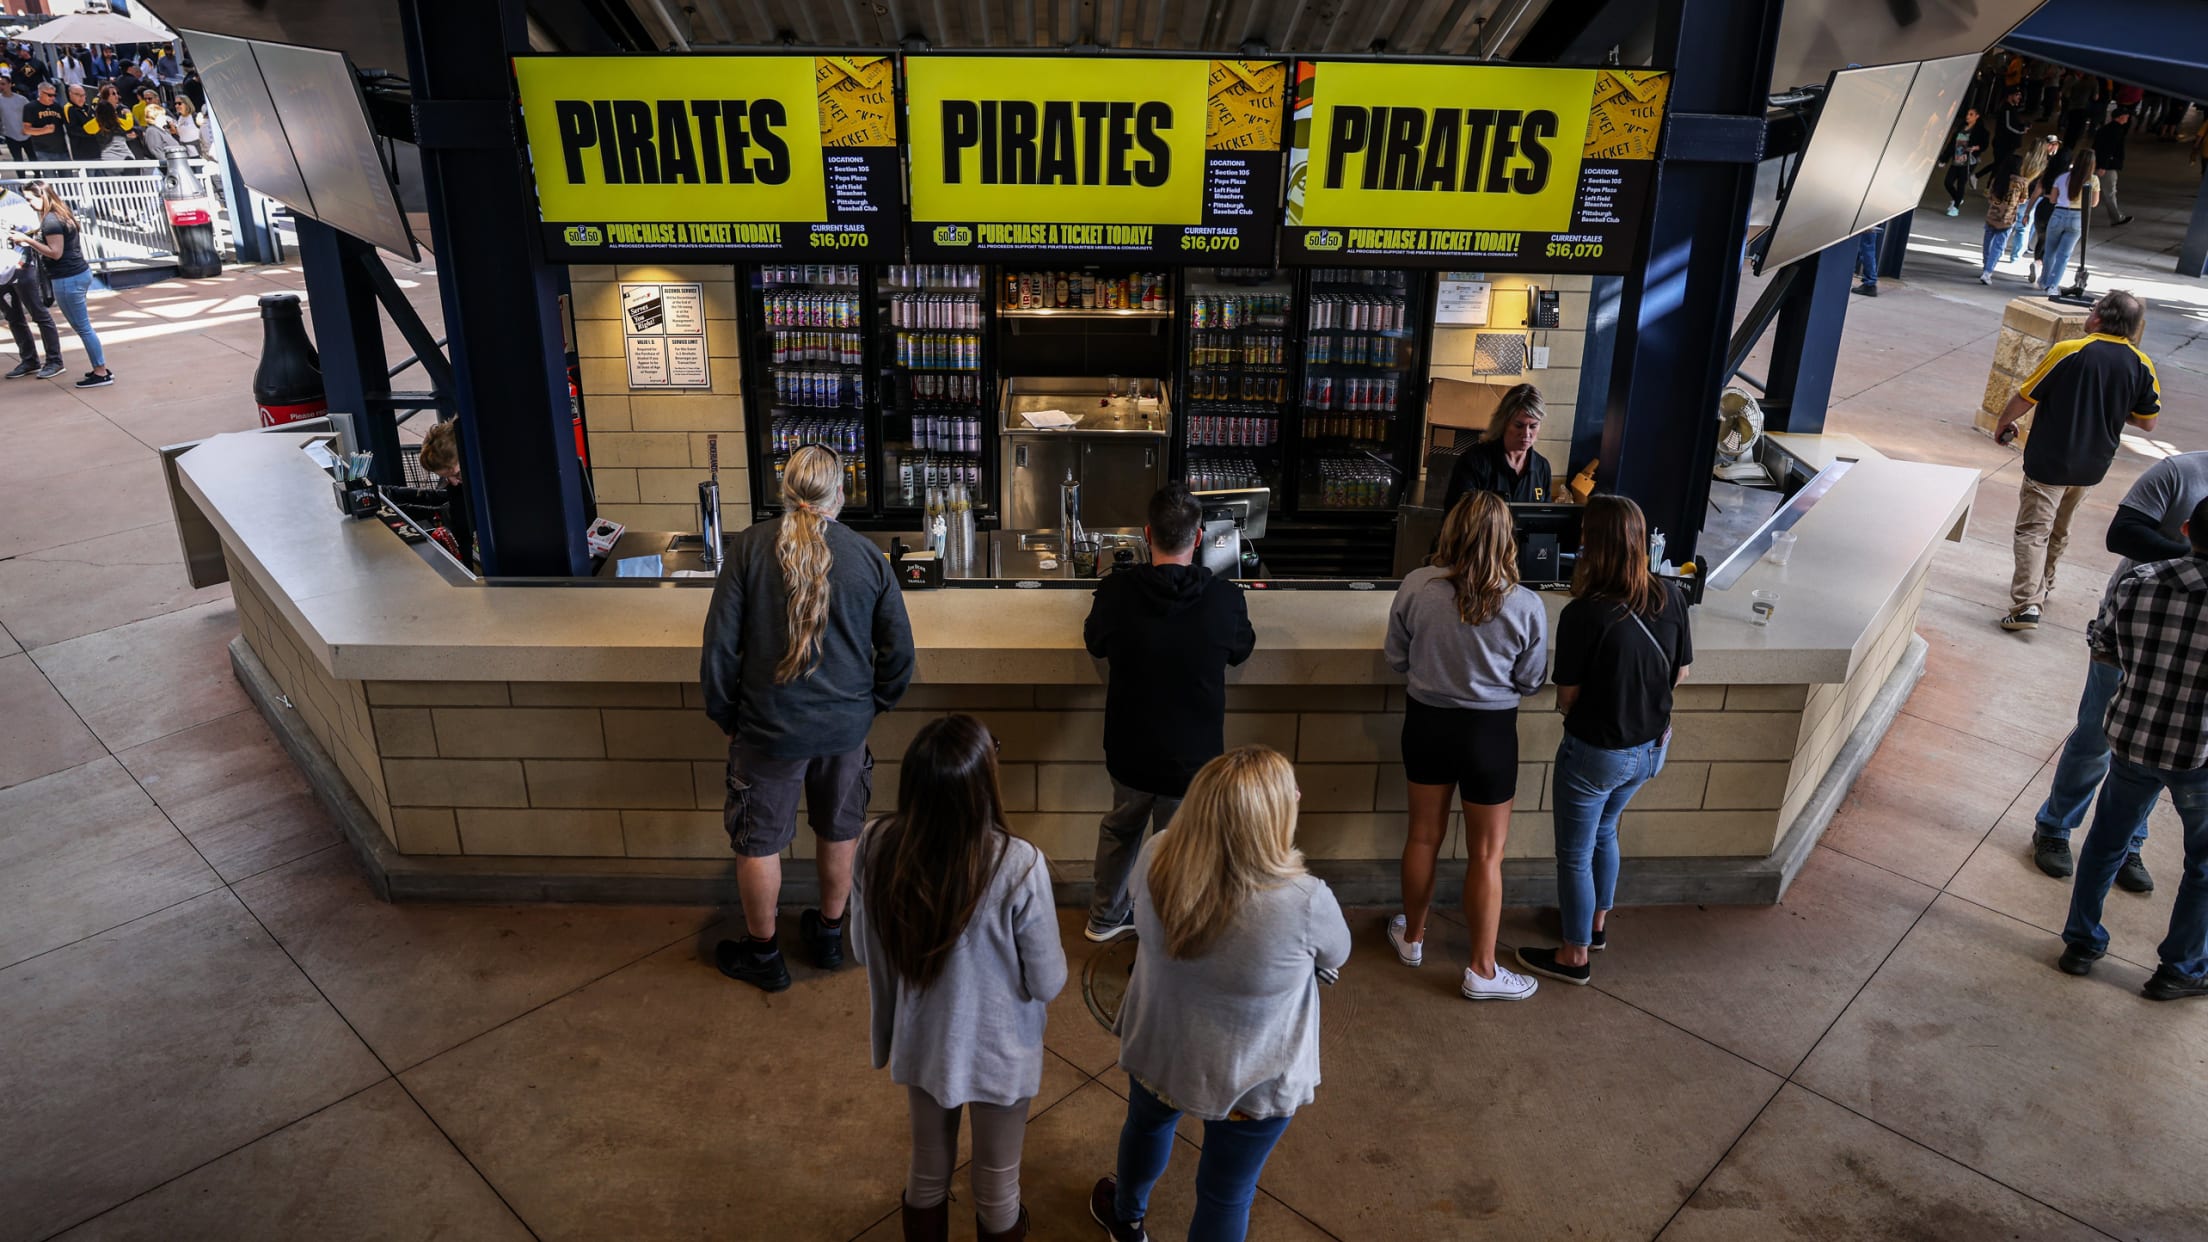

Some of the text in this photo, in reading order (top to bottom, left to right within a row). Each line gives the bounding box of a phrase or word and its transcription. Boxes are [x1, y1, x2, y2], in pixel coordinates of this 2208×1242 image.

[554, 98, 792, 185] PIRATES
[941, 99, 1174, 187] PIRATES
[1322, 105, 1559, 195] PIRATES
[569, 231, 579, 241] 50
[588, 232, 598, 241] 50
[606, 223, 782, 243] PURCHASE A TICKET TODAY!
[811, 224, 865, 232] CURRENT SALES
[938, 231, 948, 241] 50
[957, 231, 967, 241] 50
[977, 223, 1153, 245] PURCHASE A TICKET TODAY!
[1184, 227, 1238, 235] CURRENT SALES
[810, 232, 869, 250] $16,070
[1180, 235, 1240, 252] $16,070
[1309, 235, 1319, 246] 50
[1328, 235, 1339, 246] 50
[1347, 229, 1520, 251] PURCHASE A TICKET TODAY!
[1551, 234, 1603, 243] CURRENT SALES
[1545, 241, 1603, 260] $16,070
[1535, 488, 1543, 500] P
